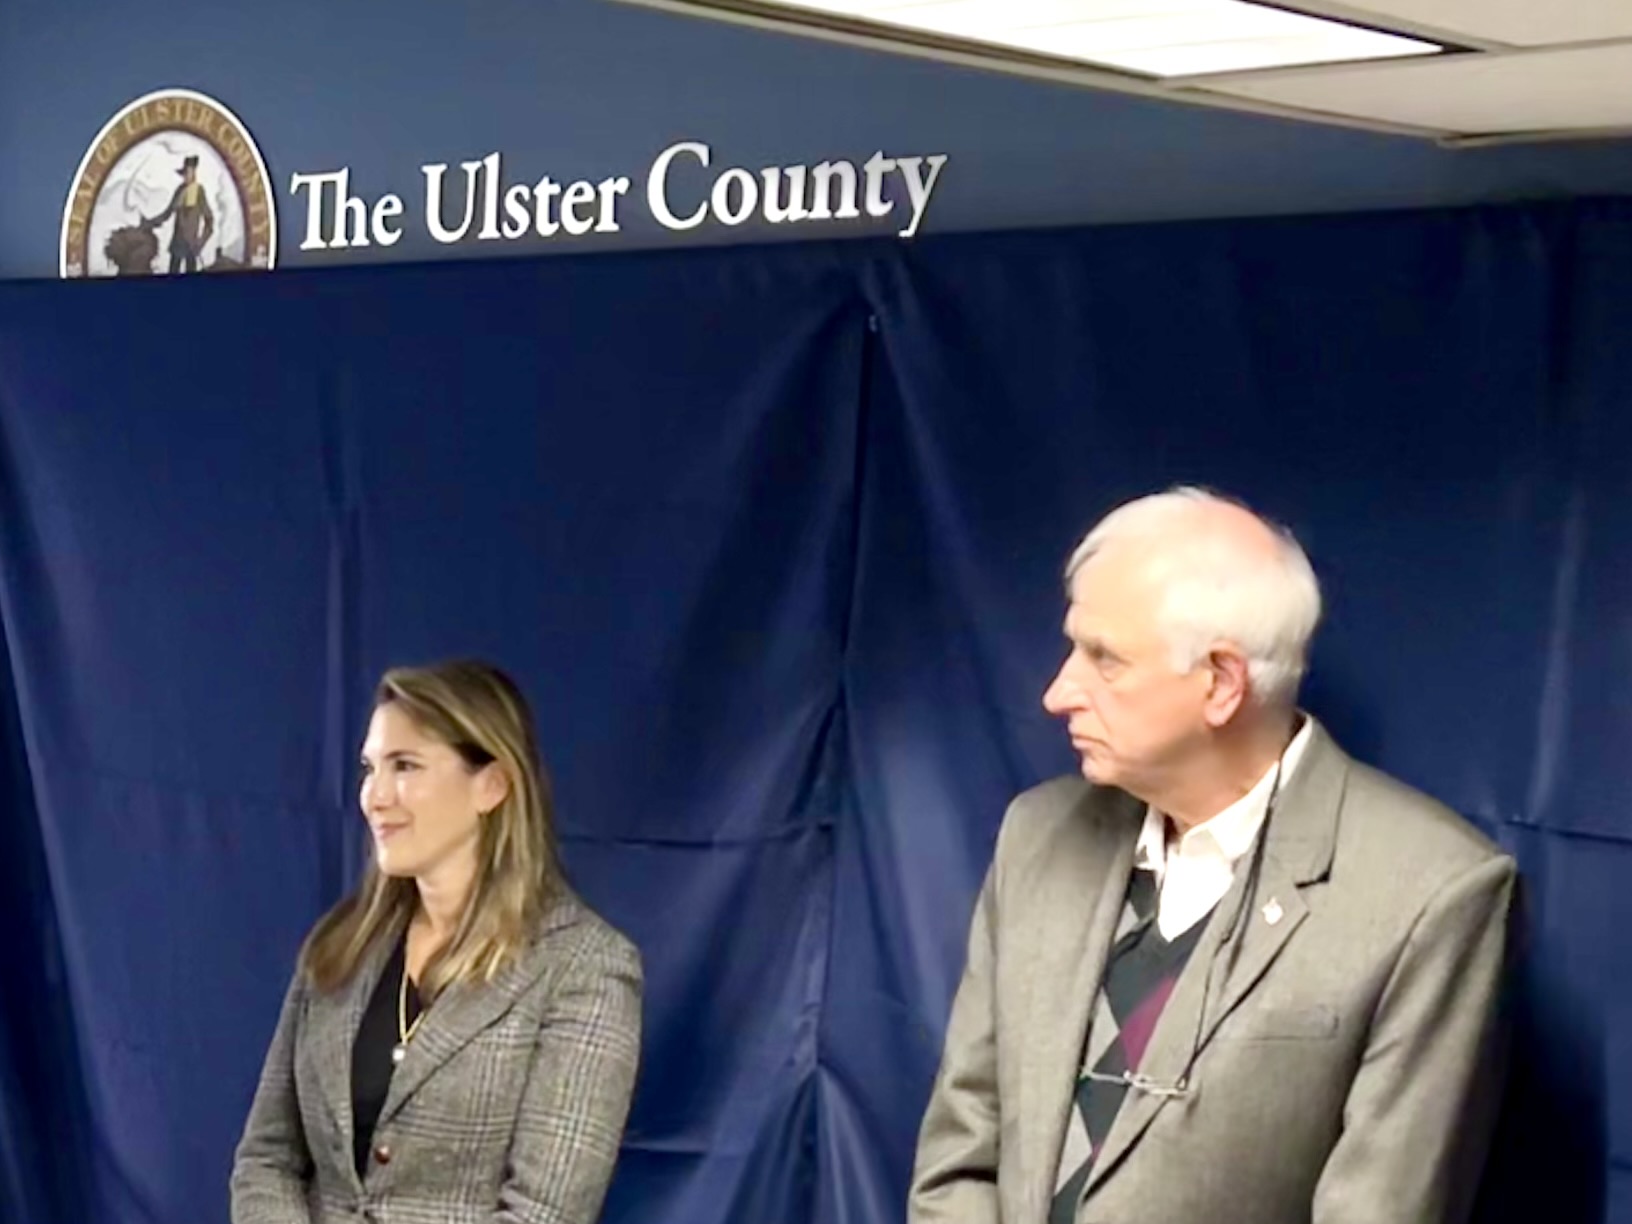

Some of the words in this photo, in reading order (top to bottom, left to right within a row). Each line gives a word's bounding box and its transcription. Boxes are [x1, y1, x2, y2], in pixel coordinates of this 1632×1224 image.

[96, 134, 118, 164] OF
[124, 99, 214, 135] ULSTER
[290, 166, 403, 250] The
[421, 151, 630, 243] Ulster
[647, 141, 948, 237] County
